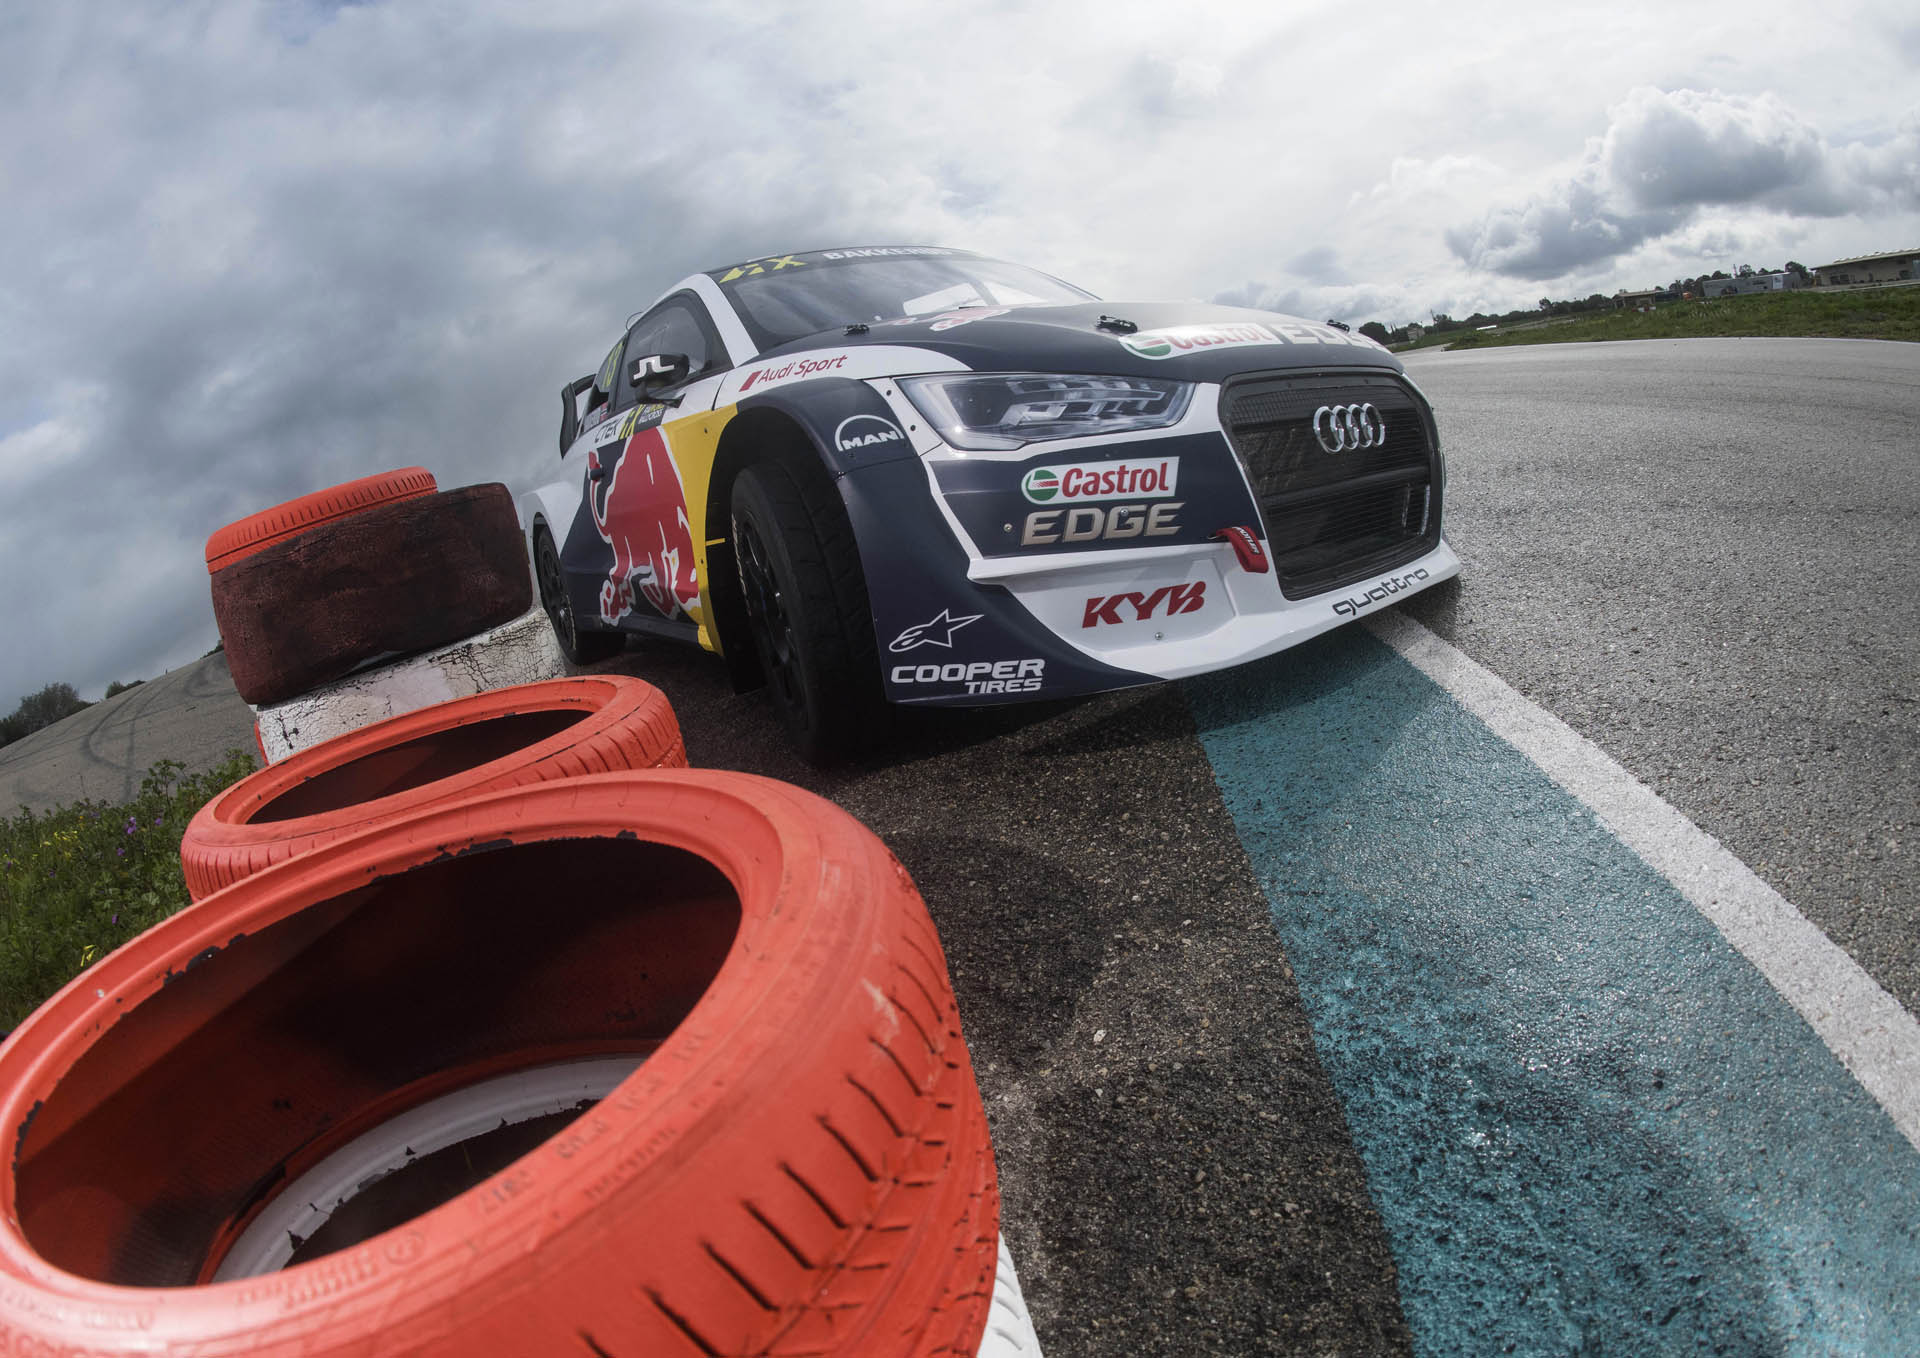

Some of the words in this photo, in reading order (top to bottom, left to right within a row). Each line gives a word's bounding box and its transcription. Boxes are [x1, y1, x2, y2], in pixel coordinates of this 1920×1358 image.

[1167, 325, 1272, 349] Castrol
[757, 362, 795, 385] Audi
[794, 354, 848, 377] Sport
[841, 430, 900, 450] MAN
[1062, 462, 1169, 498] Castrol
[1021, 502, 1187, 546] EDGE
[1082, 581, 1207, 629] KYB
[1332, 568, 1430, 616] quattro
[890, 658, 1046, 684] COOPER
[964, 677, 1043, 695] TIRES
